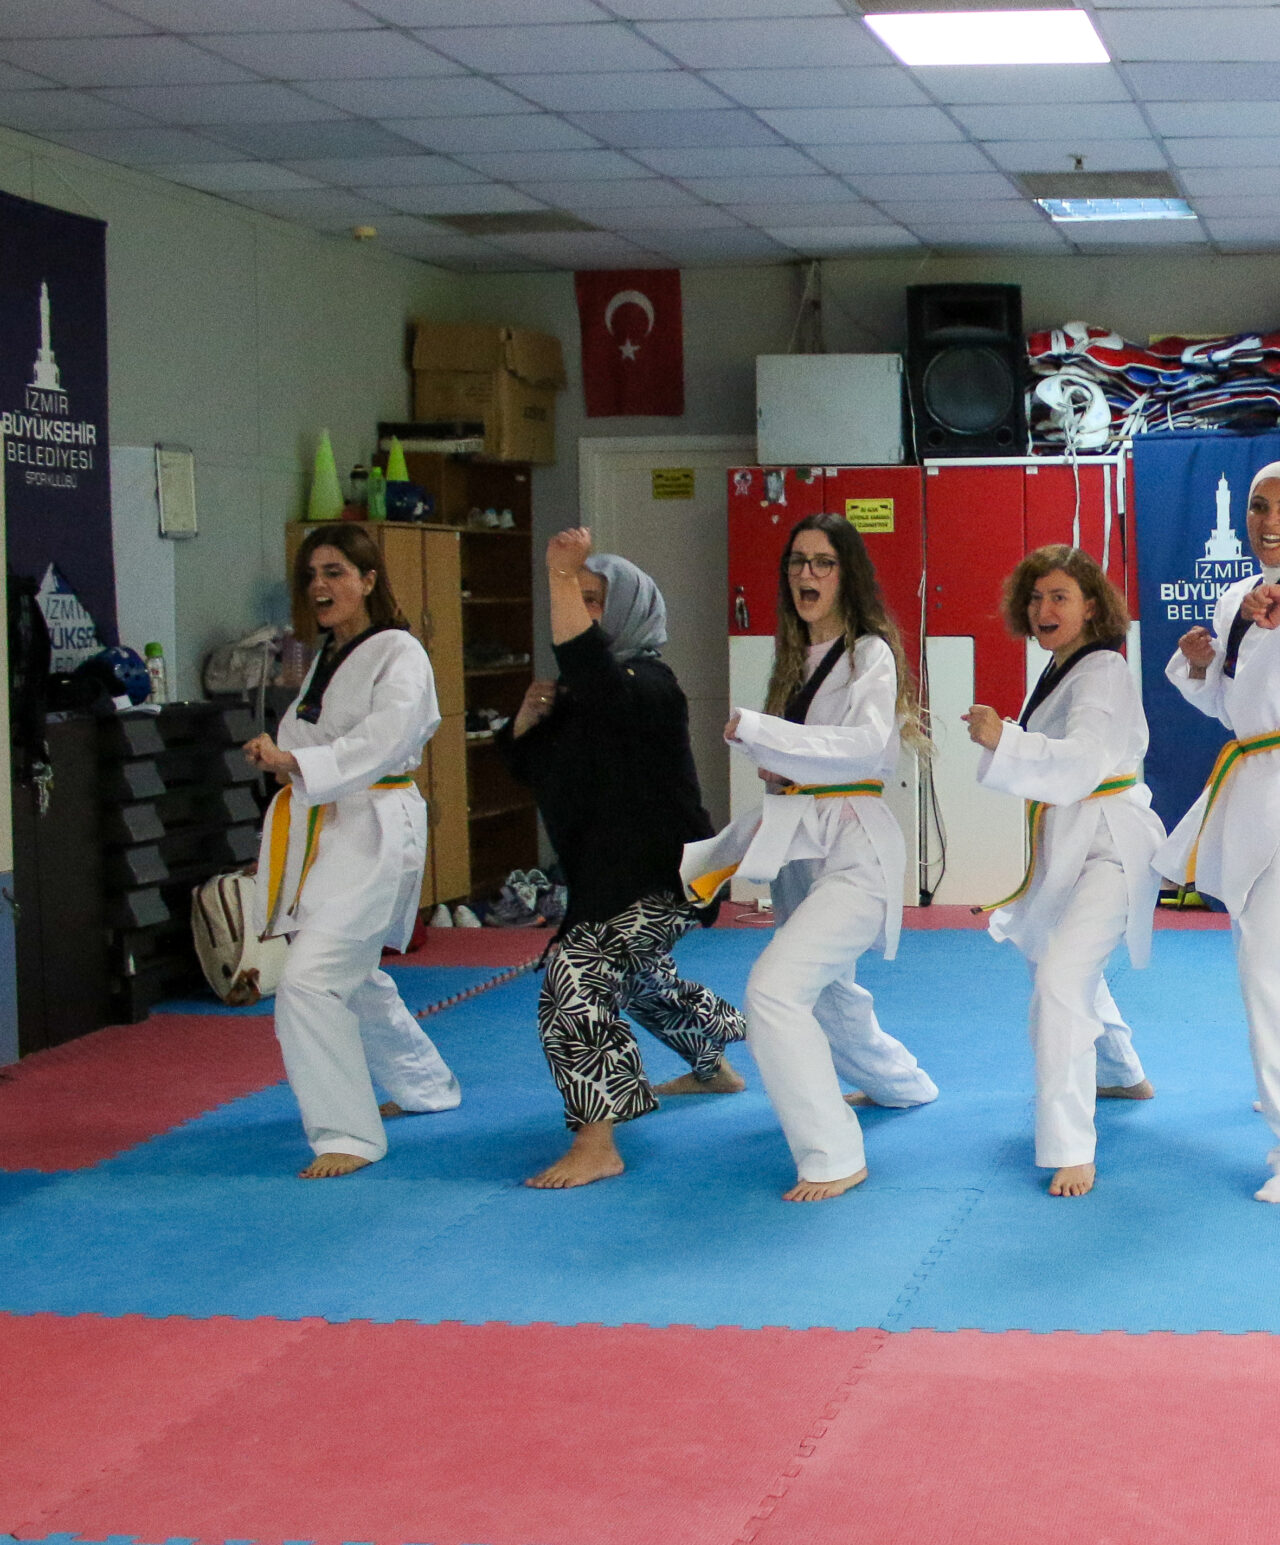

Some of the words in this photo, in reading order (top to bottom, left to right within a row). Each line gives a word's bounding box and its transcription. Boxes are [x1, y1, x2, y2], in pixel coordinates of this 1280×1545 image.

[26, 388, 69, 415] İZMİR
[2, 410, 96, 445] BÜYÜKŞEHİR
[8, 441, 93, 470] BELEDİYESİ
[1195, 561, 1254, 579] İZMİR
[1161, 580, 1230, 600] BÜYÜK
